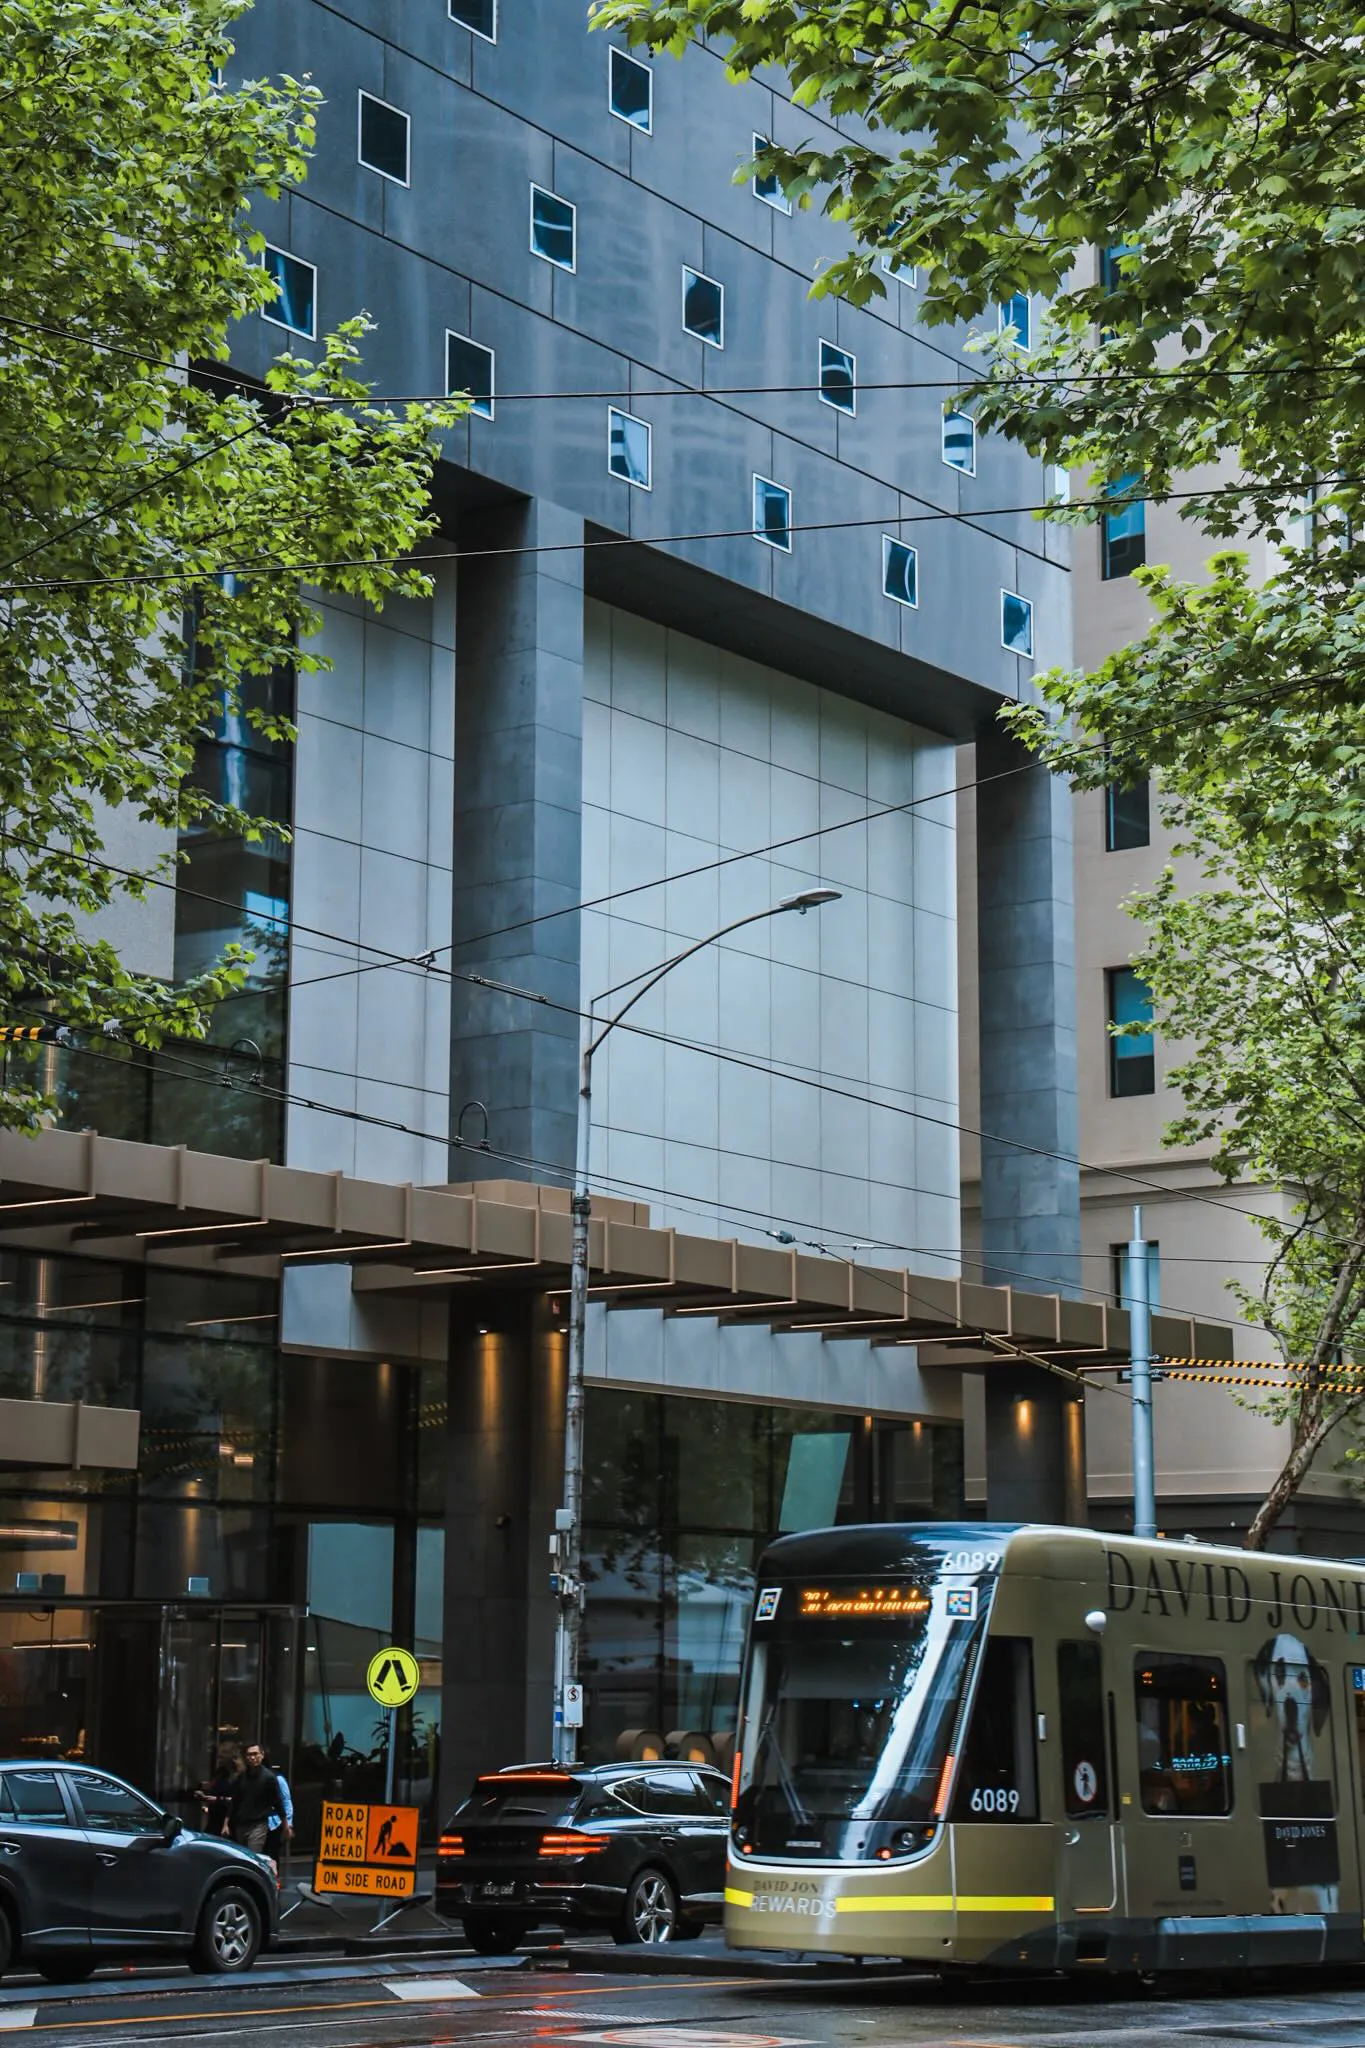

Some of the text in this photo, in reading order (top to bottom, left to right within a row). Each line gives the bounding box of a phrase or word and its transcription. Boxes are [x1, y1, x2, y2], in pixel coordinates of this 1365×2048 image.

[942, 1552, 999, 1572] 6089
[1102, 1550, 1251, 1623] DAVID
[970, 1788, 1020, 1813] 6089
[326, 1807, 364, 1822] ROAD
[325, 1825, 363, 1840] WORK
[324, 1843, 362, 1858] AHEAD
[323, 1871, 406, 1890] ON SIDE ROAD
[753, 1880, 832, 1895] DAVID JON
[750, 1894, 836, 1918] REWARDS
